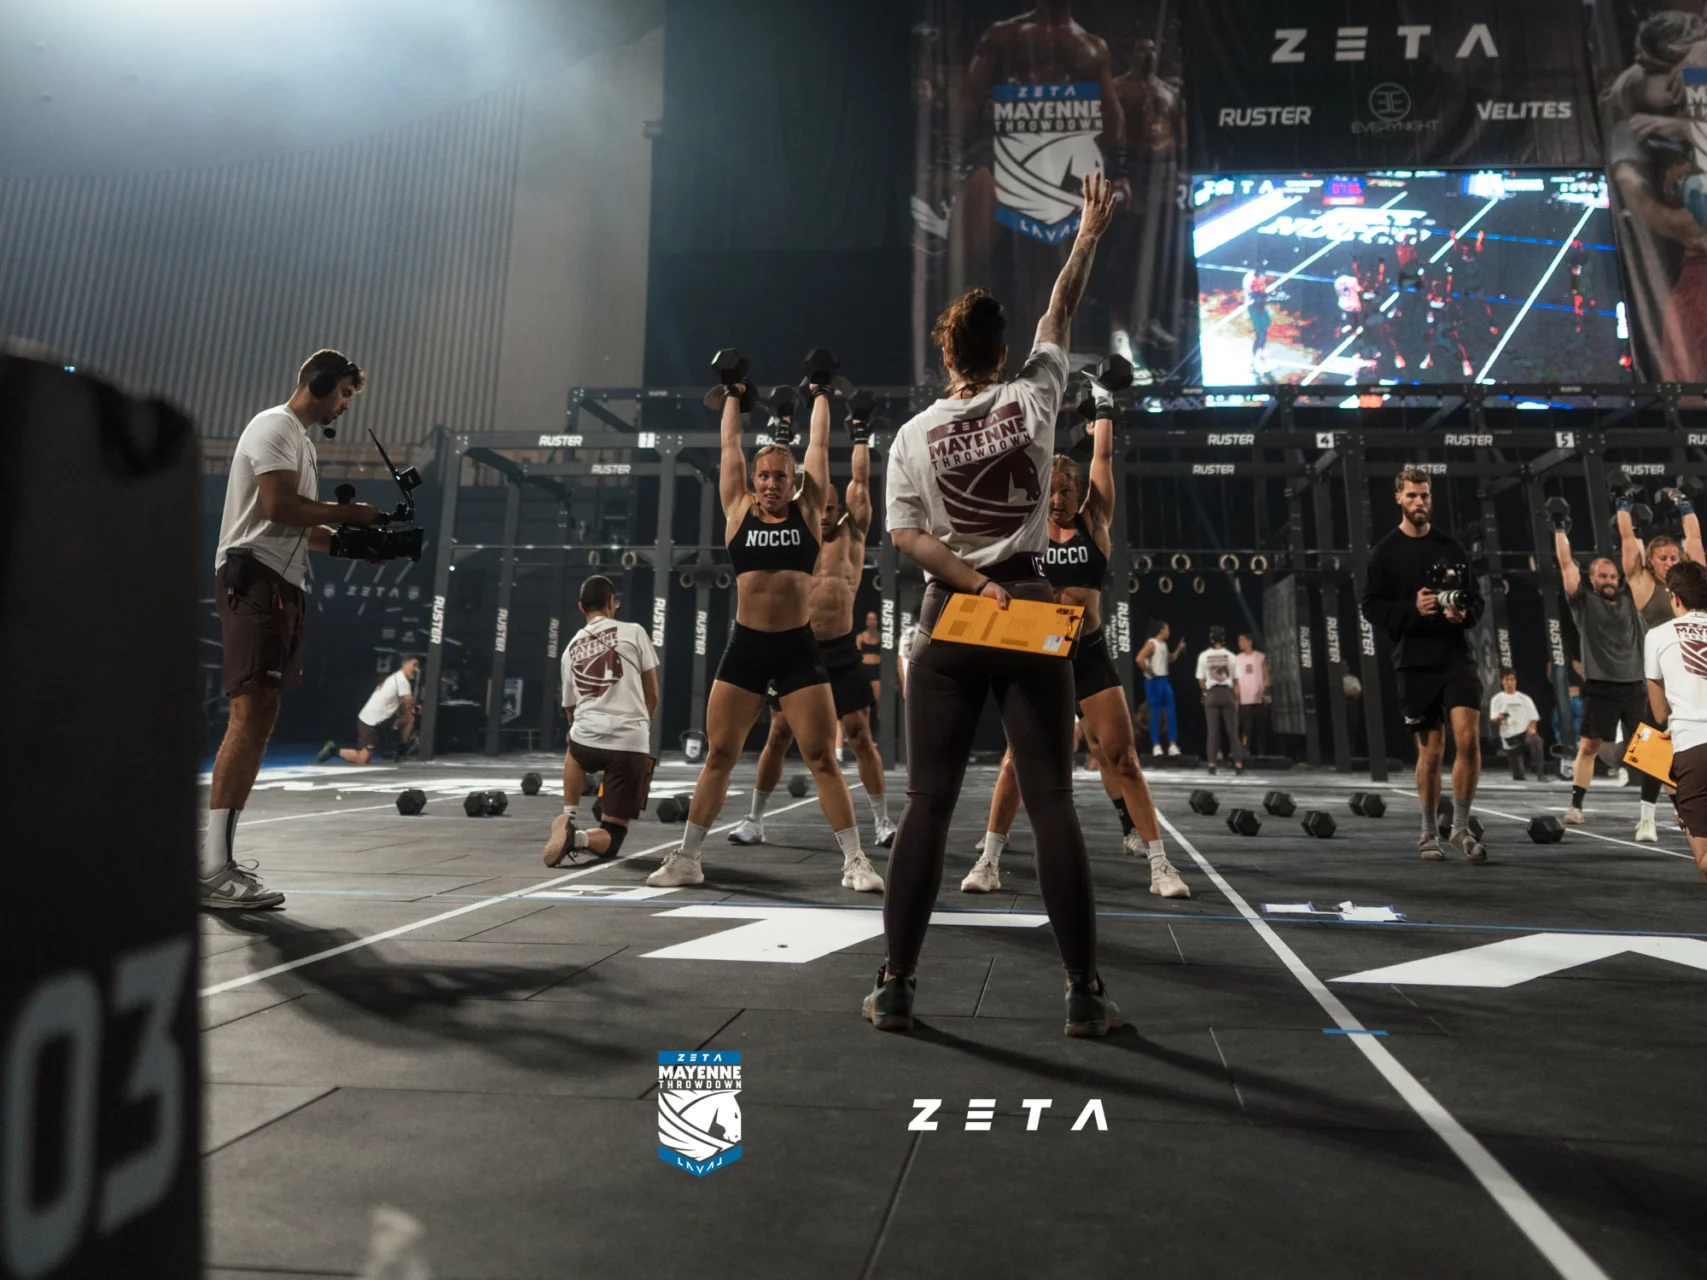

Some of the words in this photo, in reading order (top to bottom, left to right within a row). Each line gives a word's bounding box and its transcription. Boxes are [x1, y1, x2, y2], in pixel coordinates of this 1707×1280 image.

[1271, 23, 1499, 63] ZETA
[1017, 86, 1076, 98] ZETA
[994, 100, 1102, 120] MAYENNE
[1219, 106, 1312, 127] RUSTER
[1476, 100, 1572, 120] VELITES
[995, 119, 1104, 133] THROWDOWN
[947, 414, 1000, 434] ZETA
[538, 434, 583, 446] RUSTER
[929, 417, 1027, 461] MAYENNE
[931, 433, 1032, 470] THROWDOWN
[1207, 433, 1255, 446] RUSTER
[1445, 434, 1493, 446] RUSTER
[591, 464, 632, 475] RUSTER
[1192, 464, 1235, 475] RUSTER
[745, 529, 801, 547] NOCCO
[1042, 546, 1089, 565] OCCO
[430, 595, 445, 645] RUSTER
[495, 607, 509, 652] RUSTER
[652, 597, 666, 647] RUSTER
[695, 611, 707, 655] RUSTER
[881, 599, 895, 650] RUSTER
[1117, 602, 1131, 653] RUSTER
[1300, 626, 1312, 668] RUSTER
[1326, 616, 1341, 663] RUSTER
[1548, 618, 1564, 666] RUSTER
[3, 936, 193, 1280] 03
